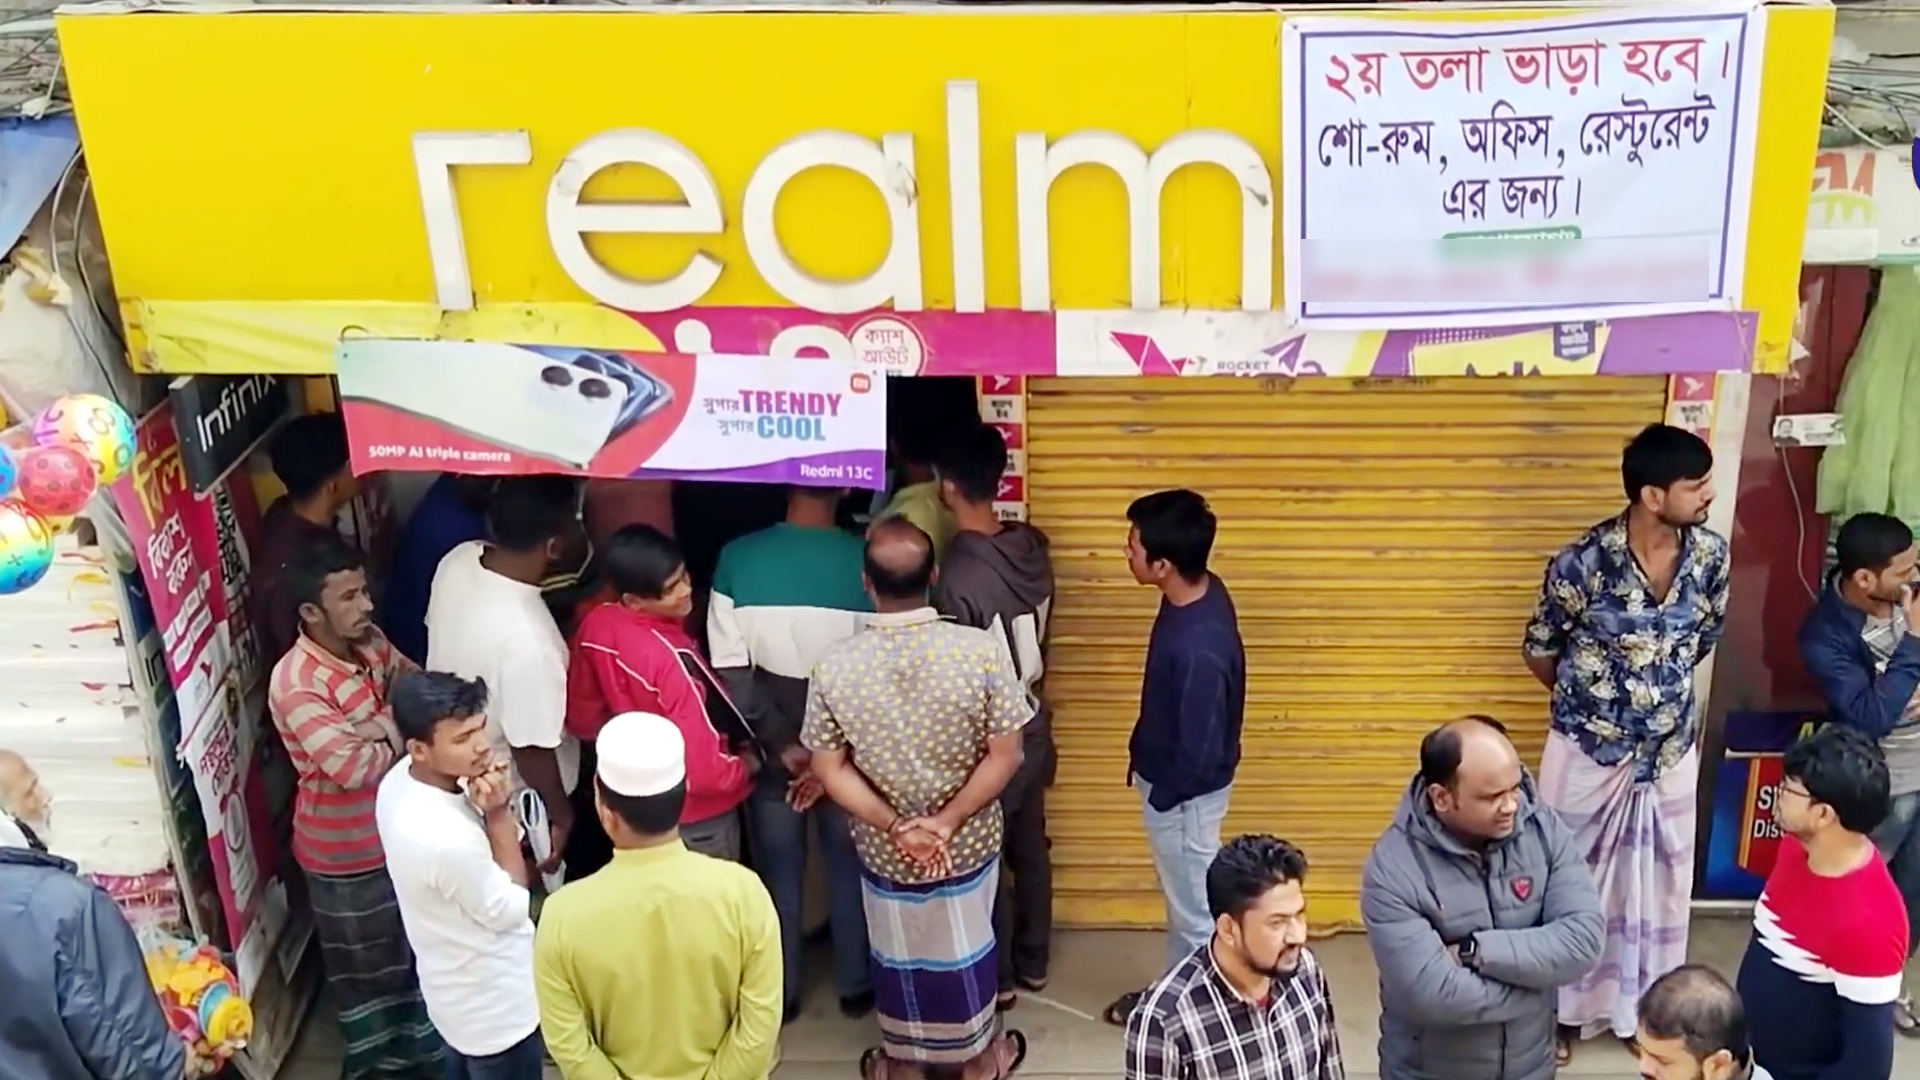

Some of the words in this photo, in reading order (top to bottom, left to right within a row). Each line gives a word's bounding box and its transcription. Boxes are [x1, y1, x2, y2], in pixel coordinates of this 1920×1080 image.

[1326, 53, 1387, 103] ২য়
[1400, 46, 1490, 94] তলা
[1504, 43, 1607, 96] ভাড়া
[1580, 91, 1718, 167] রেস্টুরেন্ট
[1442, 179, 1490, 222] এর
[865, 328, 904, 344] ক্যাশ
[862, 346, 909, 364] আউট
[1217, 361, 1270, 371] ROCKET
[703, 397, 739, 415] সুপার
[739, 389, 842, 417] TRENDY
[718, 419, 754, 436] সুপার
[757, 415, 826, 441] COOL
[369, 445, 405, 458] 50MP
[409, 446, 423, 458] AI
[426, 446, 461, 461] triple
[463, 451, 511, 463] camera
[800, 464, 843, 478] Redmi
[846, 466, 873, 480] 13C
